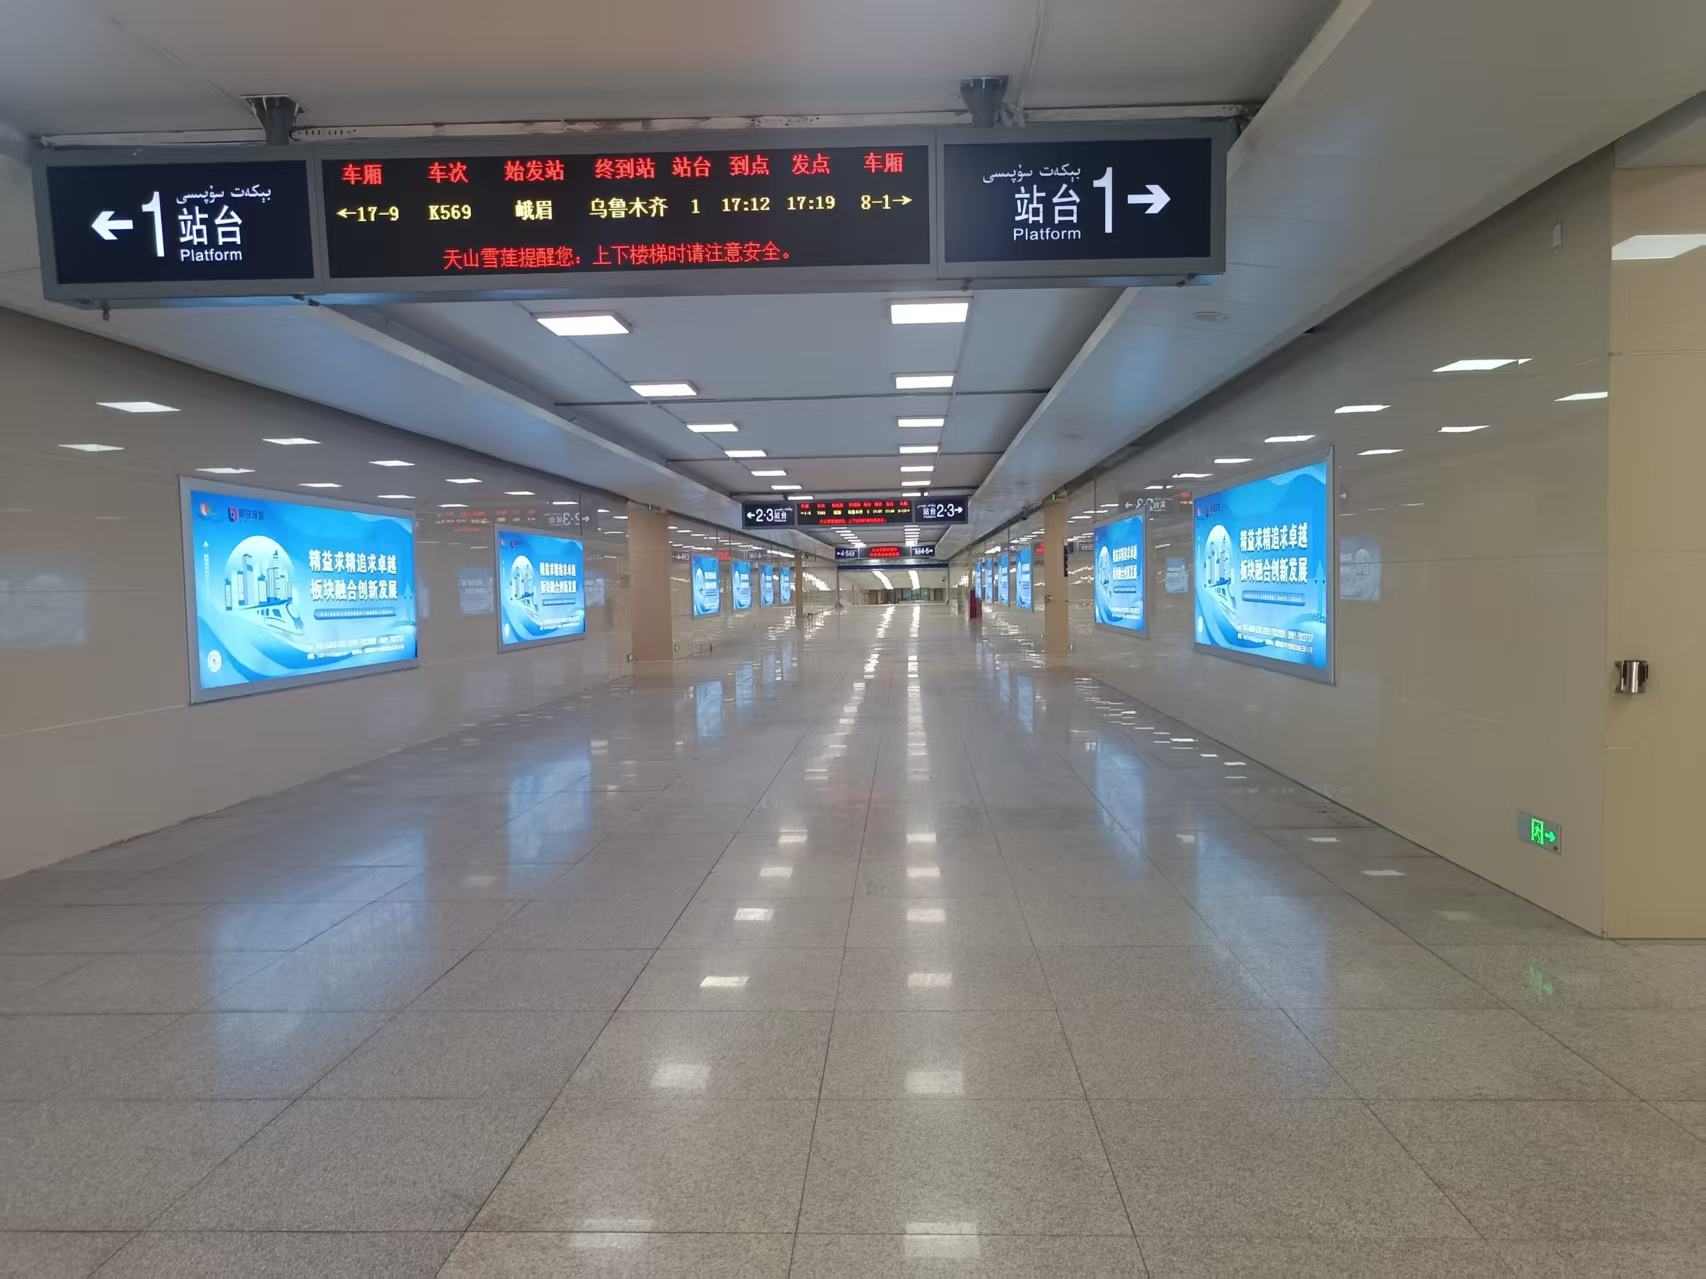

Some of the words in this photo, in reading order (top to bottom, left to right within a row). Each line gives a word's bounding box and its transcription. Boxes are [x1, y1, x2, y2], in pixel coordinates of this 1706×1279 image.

[342, 163, 383, 186] 车厢
[427, 161, 470, 184] 车次
[504, 159, 565, 182] 始发站
[594, 157, 656, 180] 终到站
[671, 155, 712, 179] 站台
[729, 154, 770, 177] 到点
[791, 153, 831, 176] 发点
[863, 152, 905, 175] 车厢
[428, 204, 472, 221] K569
[514, 199, 553, 221] 峨眉
[589, 196, 669, 220] 乌鲁木齐
[691, 198, 701, 214] 1
[721, 196, 770, 213] 17:12
[786, 195, 836, 211] 17:19
[1014, 184, 1081, 224] 站台
[1092, 166, 1113, 234] 1
[141, 191, 165, 257] 1
[177, 205, 243, 246] 站台
[1013, 227, 1082, 241] Platform
[180, 248, 243, 262] Platform
[1239, 521, 1308, 553] 精益求精追求卓越
[308, 548, 398, 575] 精益求精追求卓越
[1239, 556, 1309, 584] 板块融合创新发展
[309, 579, 398, 601] 板块融合创新发展
